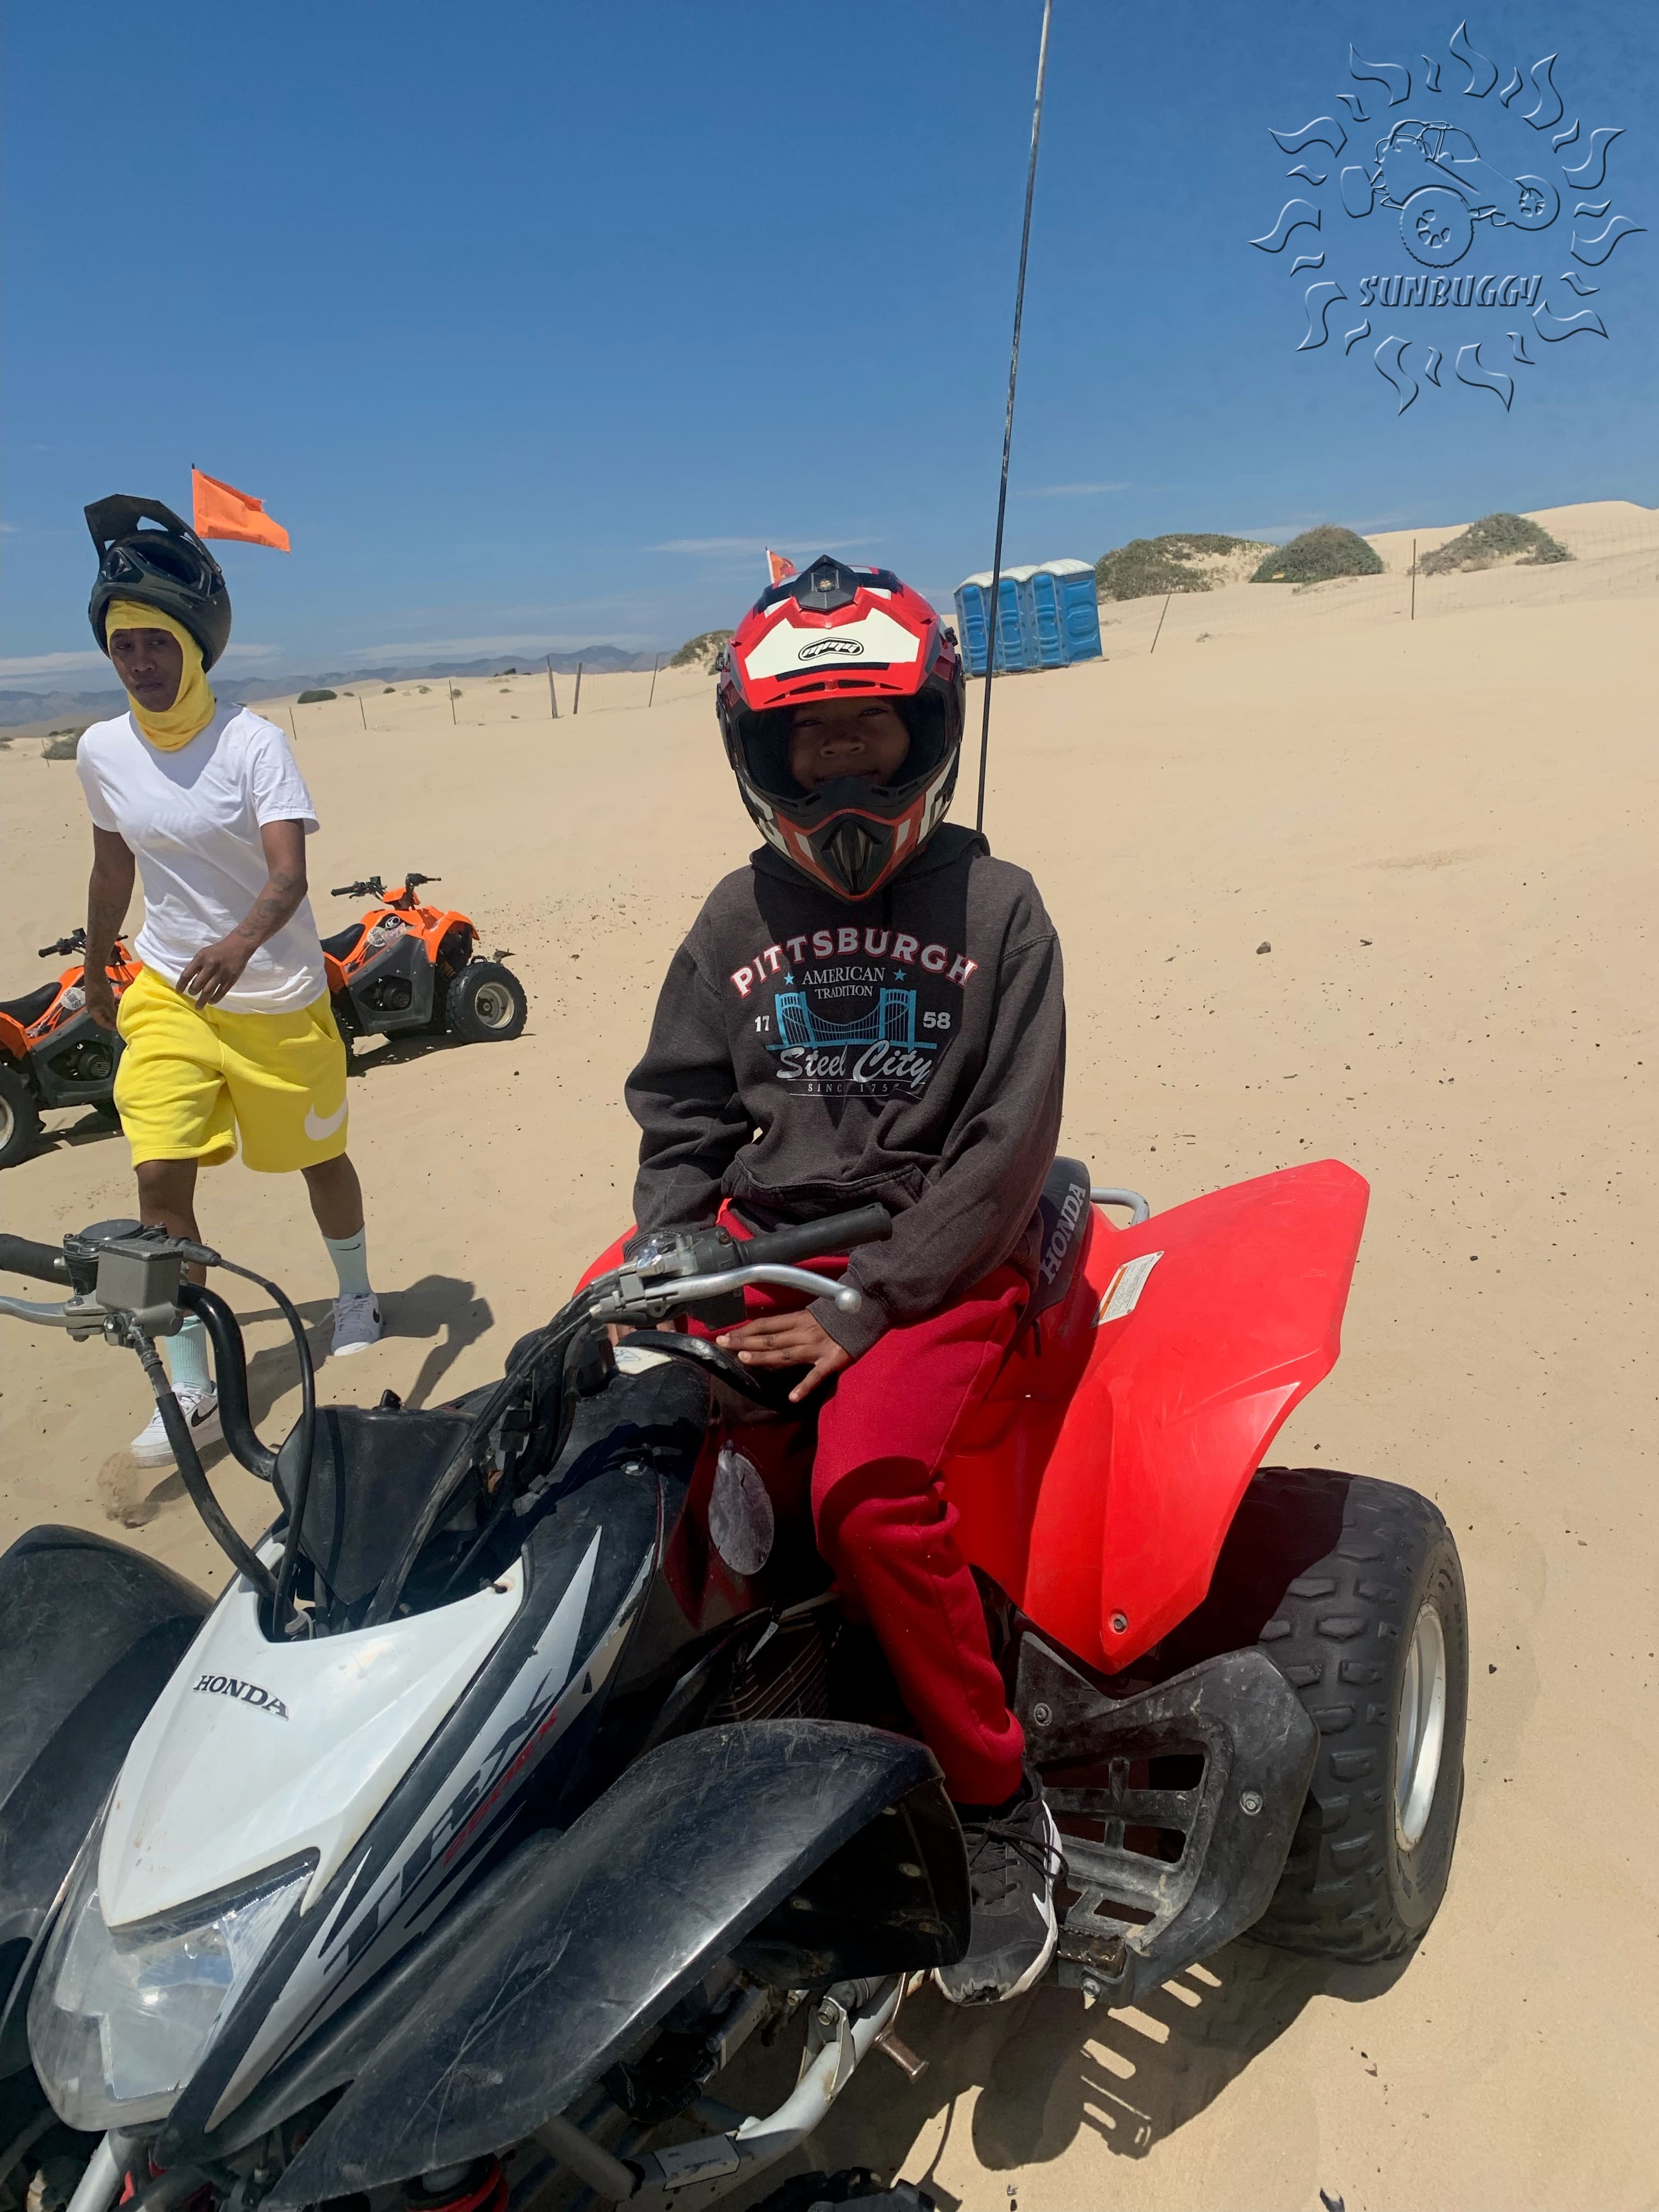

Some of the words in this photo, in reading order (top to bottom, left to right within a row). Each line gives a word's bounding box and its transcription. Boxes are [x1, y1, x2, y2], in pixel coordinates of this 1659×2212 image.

[730, 927, 979, 998] PITTSBURGH
[802, 966, 886, 985] AMERICAN
[815, 985, 873, 1000] TRADITION
[922, 1011, 951, 1030] 58
[776, 1042, 848, 1079] Steel
[852, 1039, 933, 1089] City
[808, 1083, 844, 1093] SINC
[1041, 1182, 1086, 1285] HONDA
[193, 1674, 289, 1719] HONDA
[323, 1667, 555, 1976] TRX
